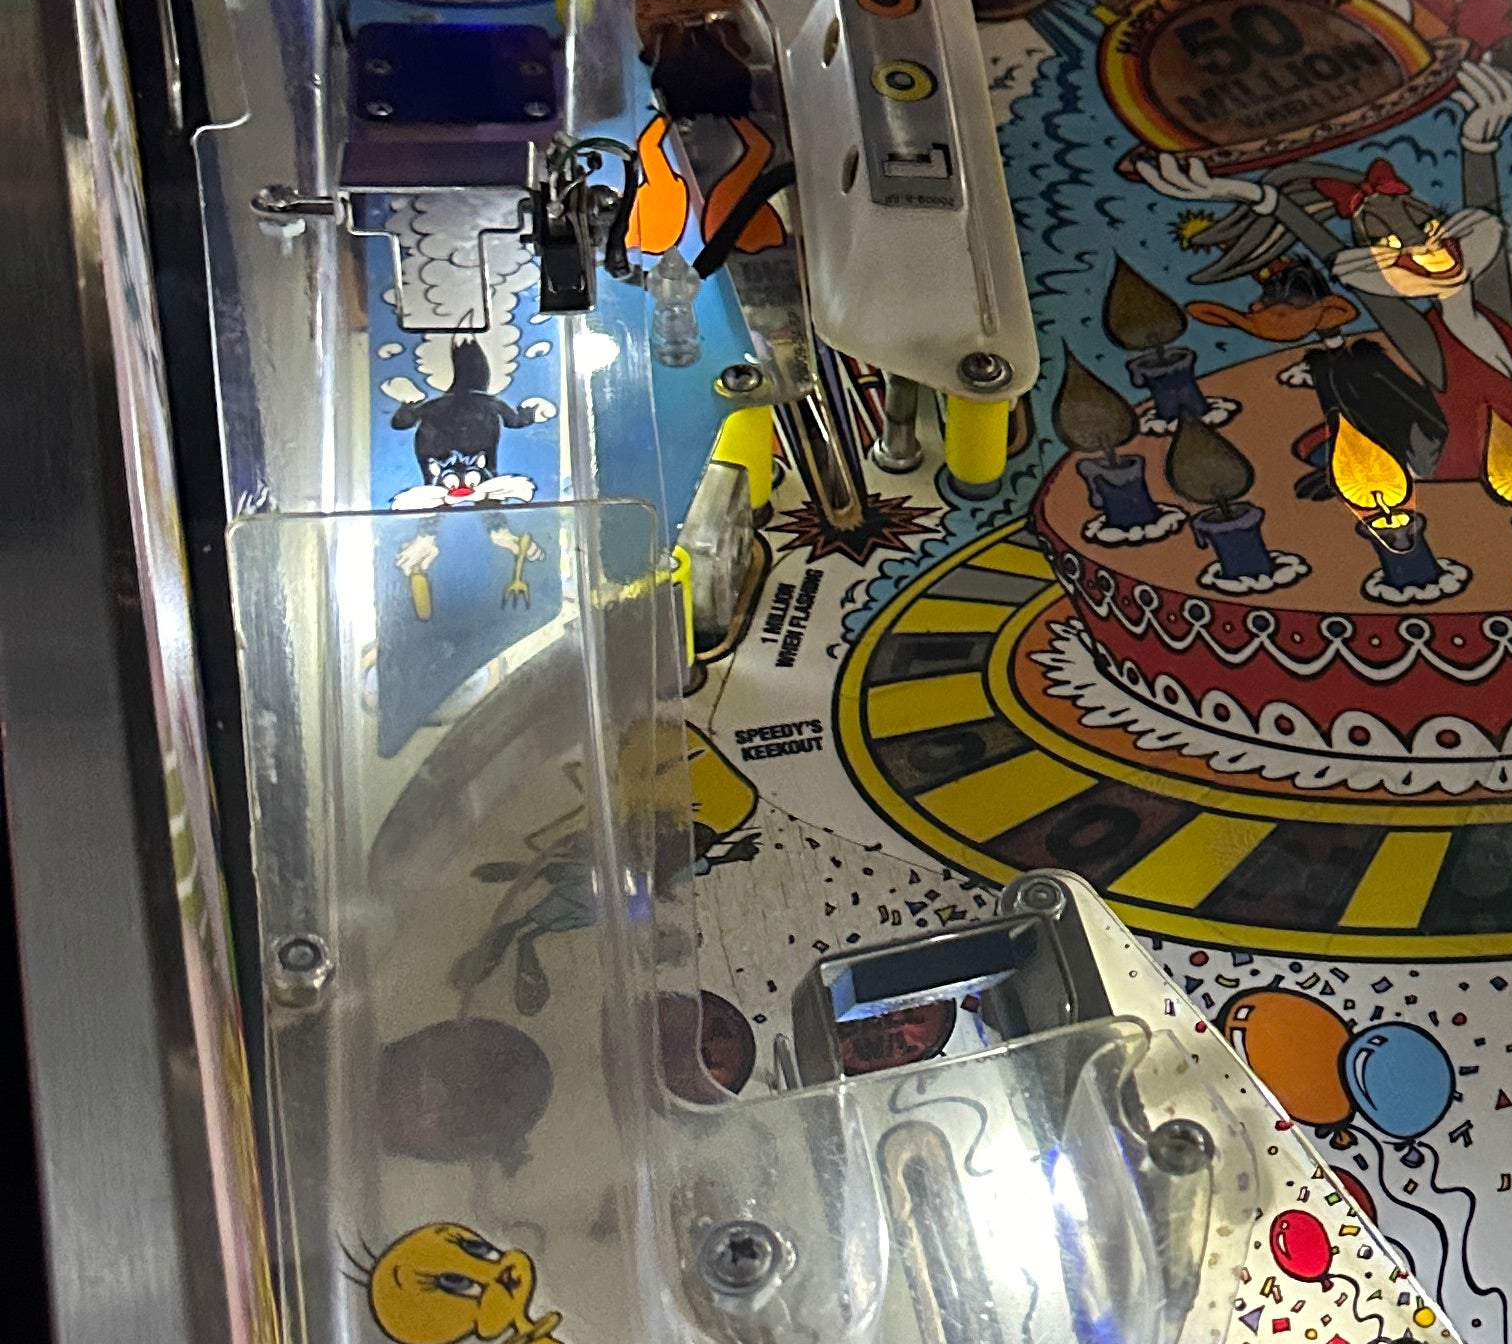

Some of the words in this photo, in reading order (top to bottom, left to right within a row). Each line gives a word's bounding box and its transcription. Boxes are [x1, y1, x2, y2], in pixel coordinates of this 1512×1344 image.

[1177, 3, 1304, 77] 50
[763, 582, 796, 635] MILLION
[789, 569, 825, 629] FLASHING
[775, 629, 804, 667] WHEN
[734, 719, 823, 745] SPEEDY'S
[741, 737, 823, 761] KEEKOUT
